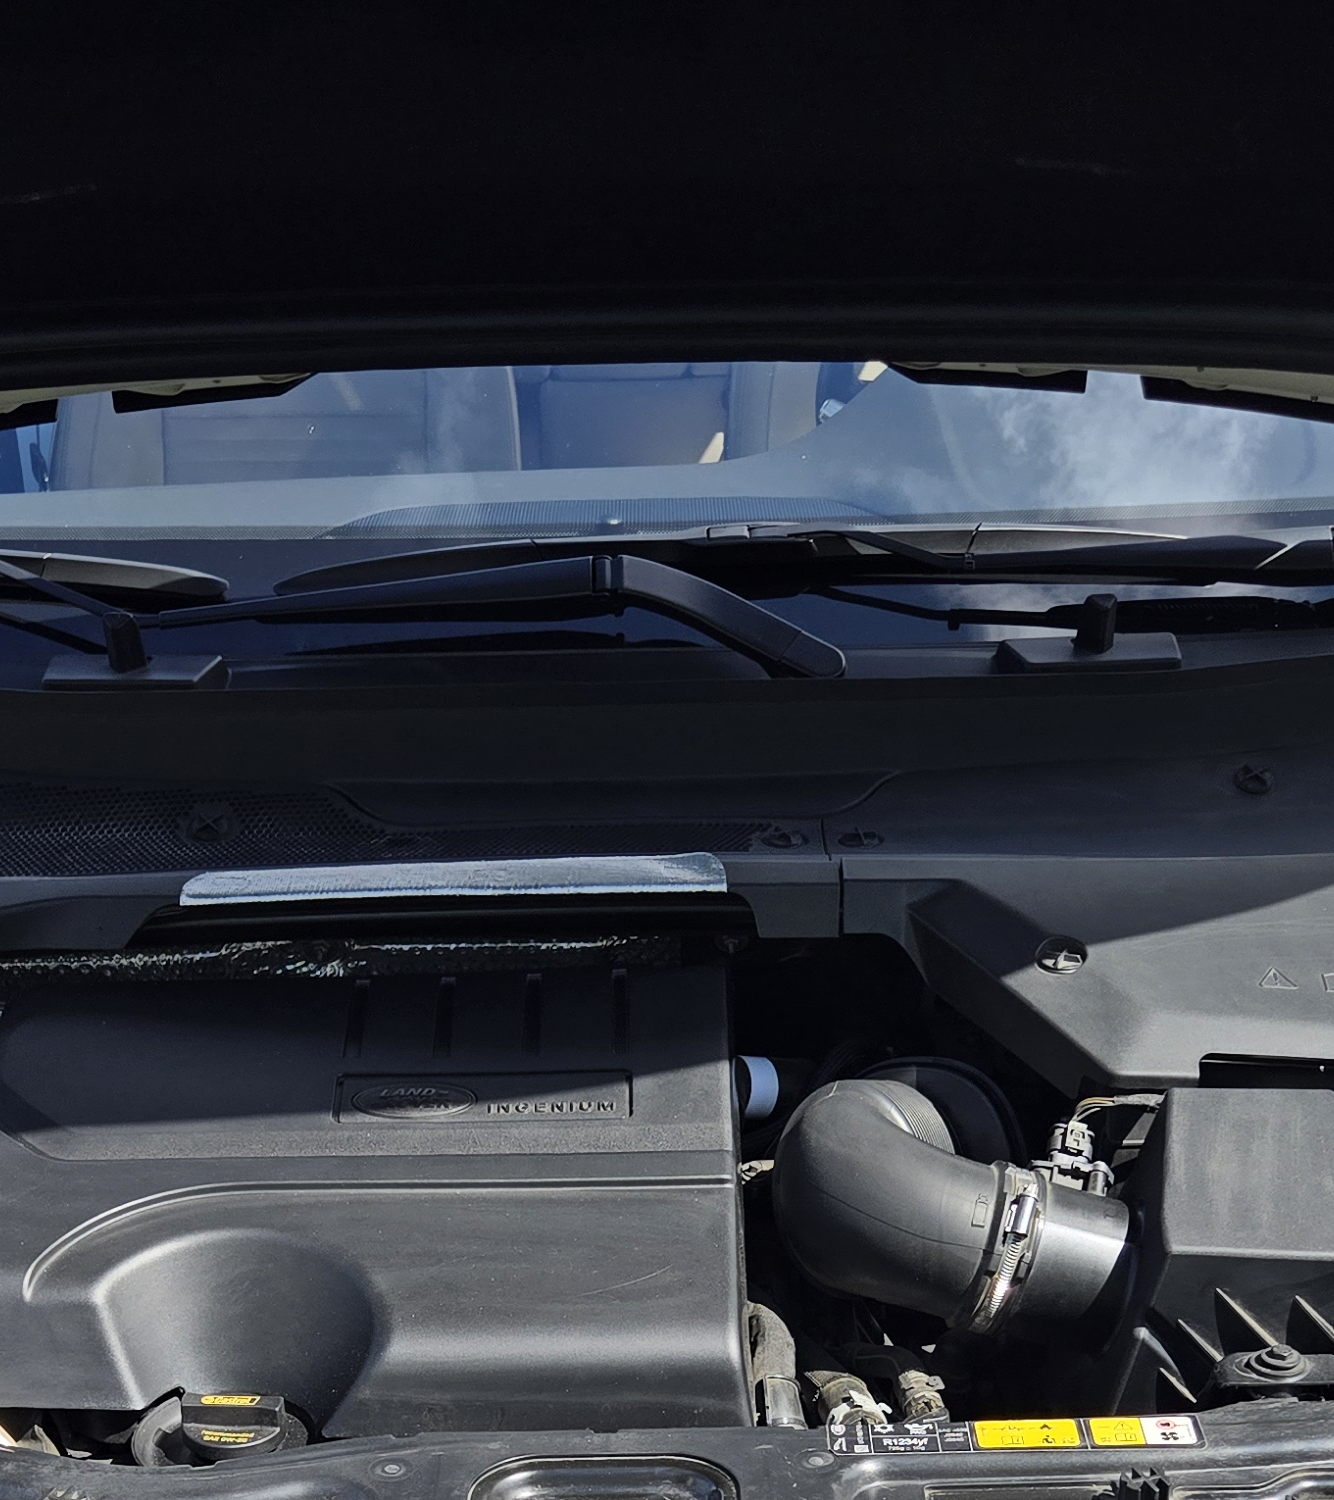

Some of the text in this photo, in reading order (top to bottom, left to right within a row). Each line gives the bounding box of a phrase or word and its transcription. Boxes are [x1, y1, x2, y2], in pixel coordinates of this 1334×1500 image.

[378, 1086, 437, 1098] LAND
[486, 1101, 616, 1115] INGENIUM
[883, 1437, 929, 1447] R1234yf
